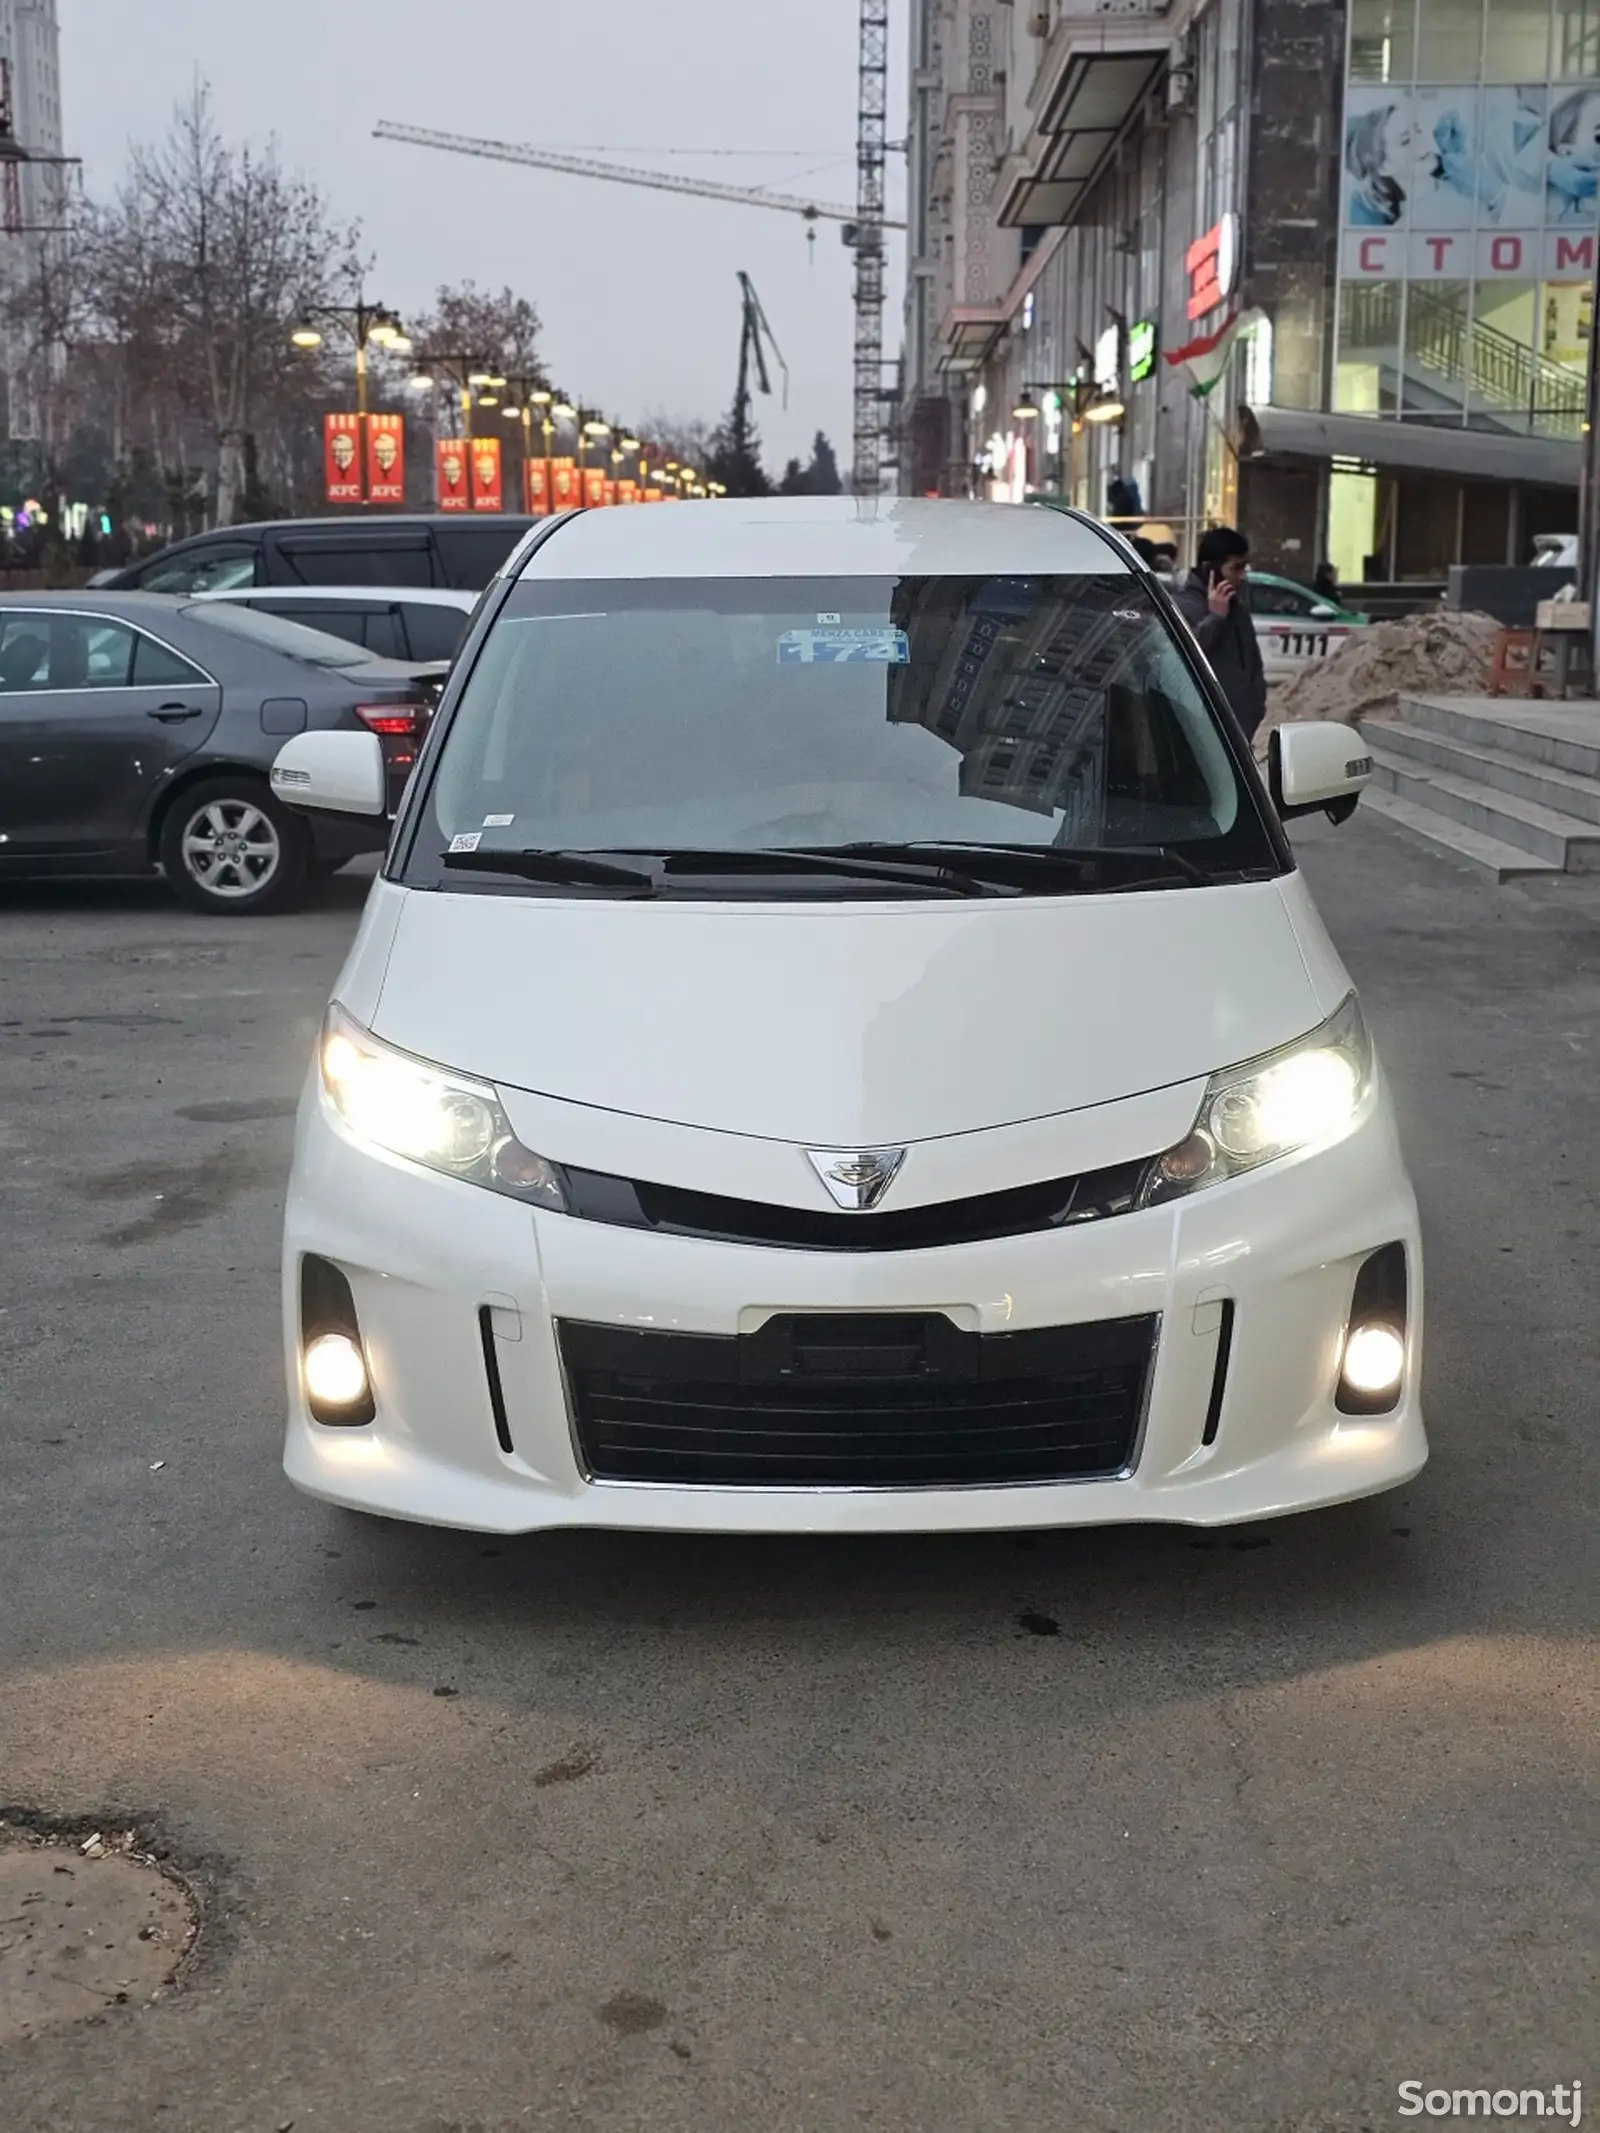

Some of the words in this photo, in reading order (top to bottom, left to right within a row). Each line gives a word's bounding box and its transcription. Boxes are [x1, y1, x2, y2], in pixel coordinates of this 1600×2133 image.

[328, 484, 360, 497] KFC
[371, 485, 402, 497] KFC
[442, 497, 467, 507] KFC
[474, 496, 500, 507] KFC
[1279, 633, 1329, 657] 1111
